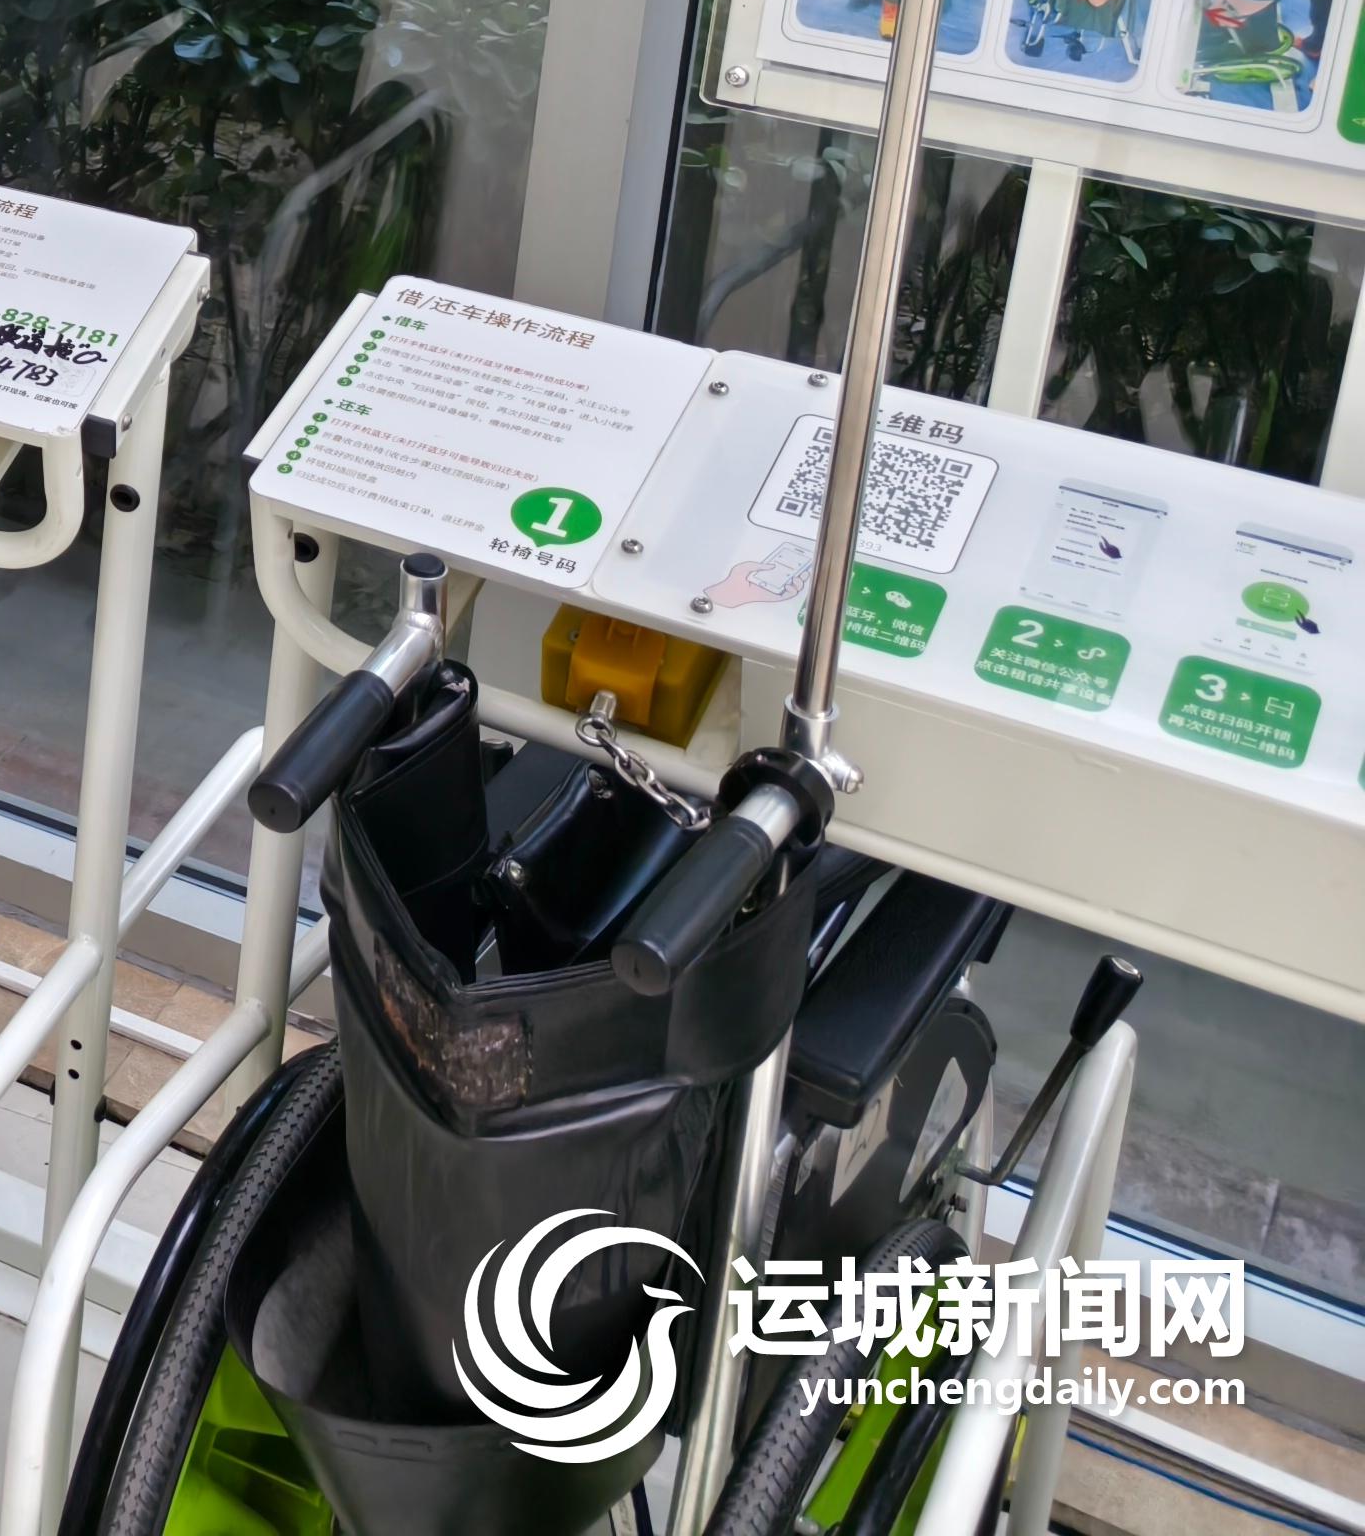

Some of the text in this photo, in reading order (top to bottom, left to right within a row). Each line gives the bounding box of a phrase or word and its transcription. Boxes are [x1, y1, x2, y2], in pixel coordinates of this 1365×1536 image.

[393, 315, 429, 331] 借车
[396, 288, 595, 350] 借/还车操作流程
[336, 399, 372, 415] 还车
[531, 496, 574, 538] 1
[489, 536, 577, 574] 轮椅号码
[1011, 619, 1044, 648] 2
[977, 660, 1111, 705] 点击租借共享设备
[990, 647, 1109, 689] 关注微信公众号
[1195, 674, 1228, 702] 3
[1168, 714, 1296, 761] 再次识别二维码
[1181, 703, 1291, 744] 点击扫码开锁
